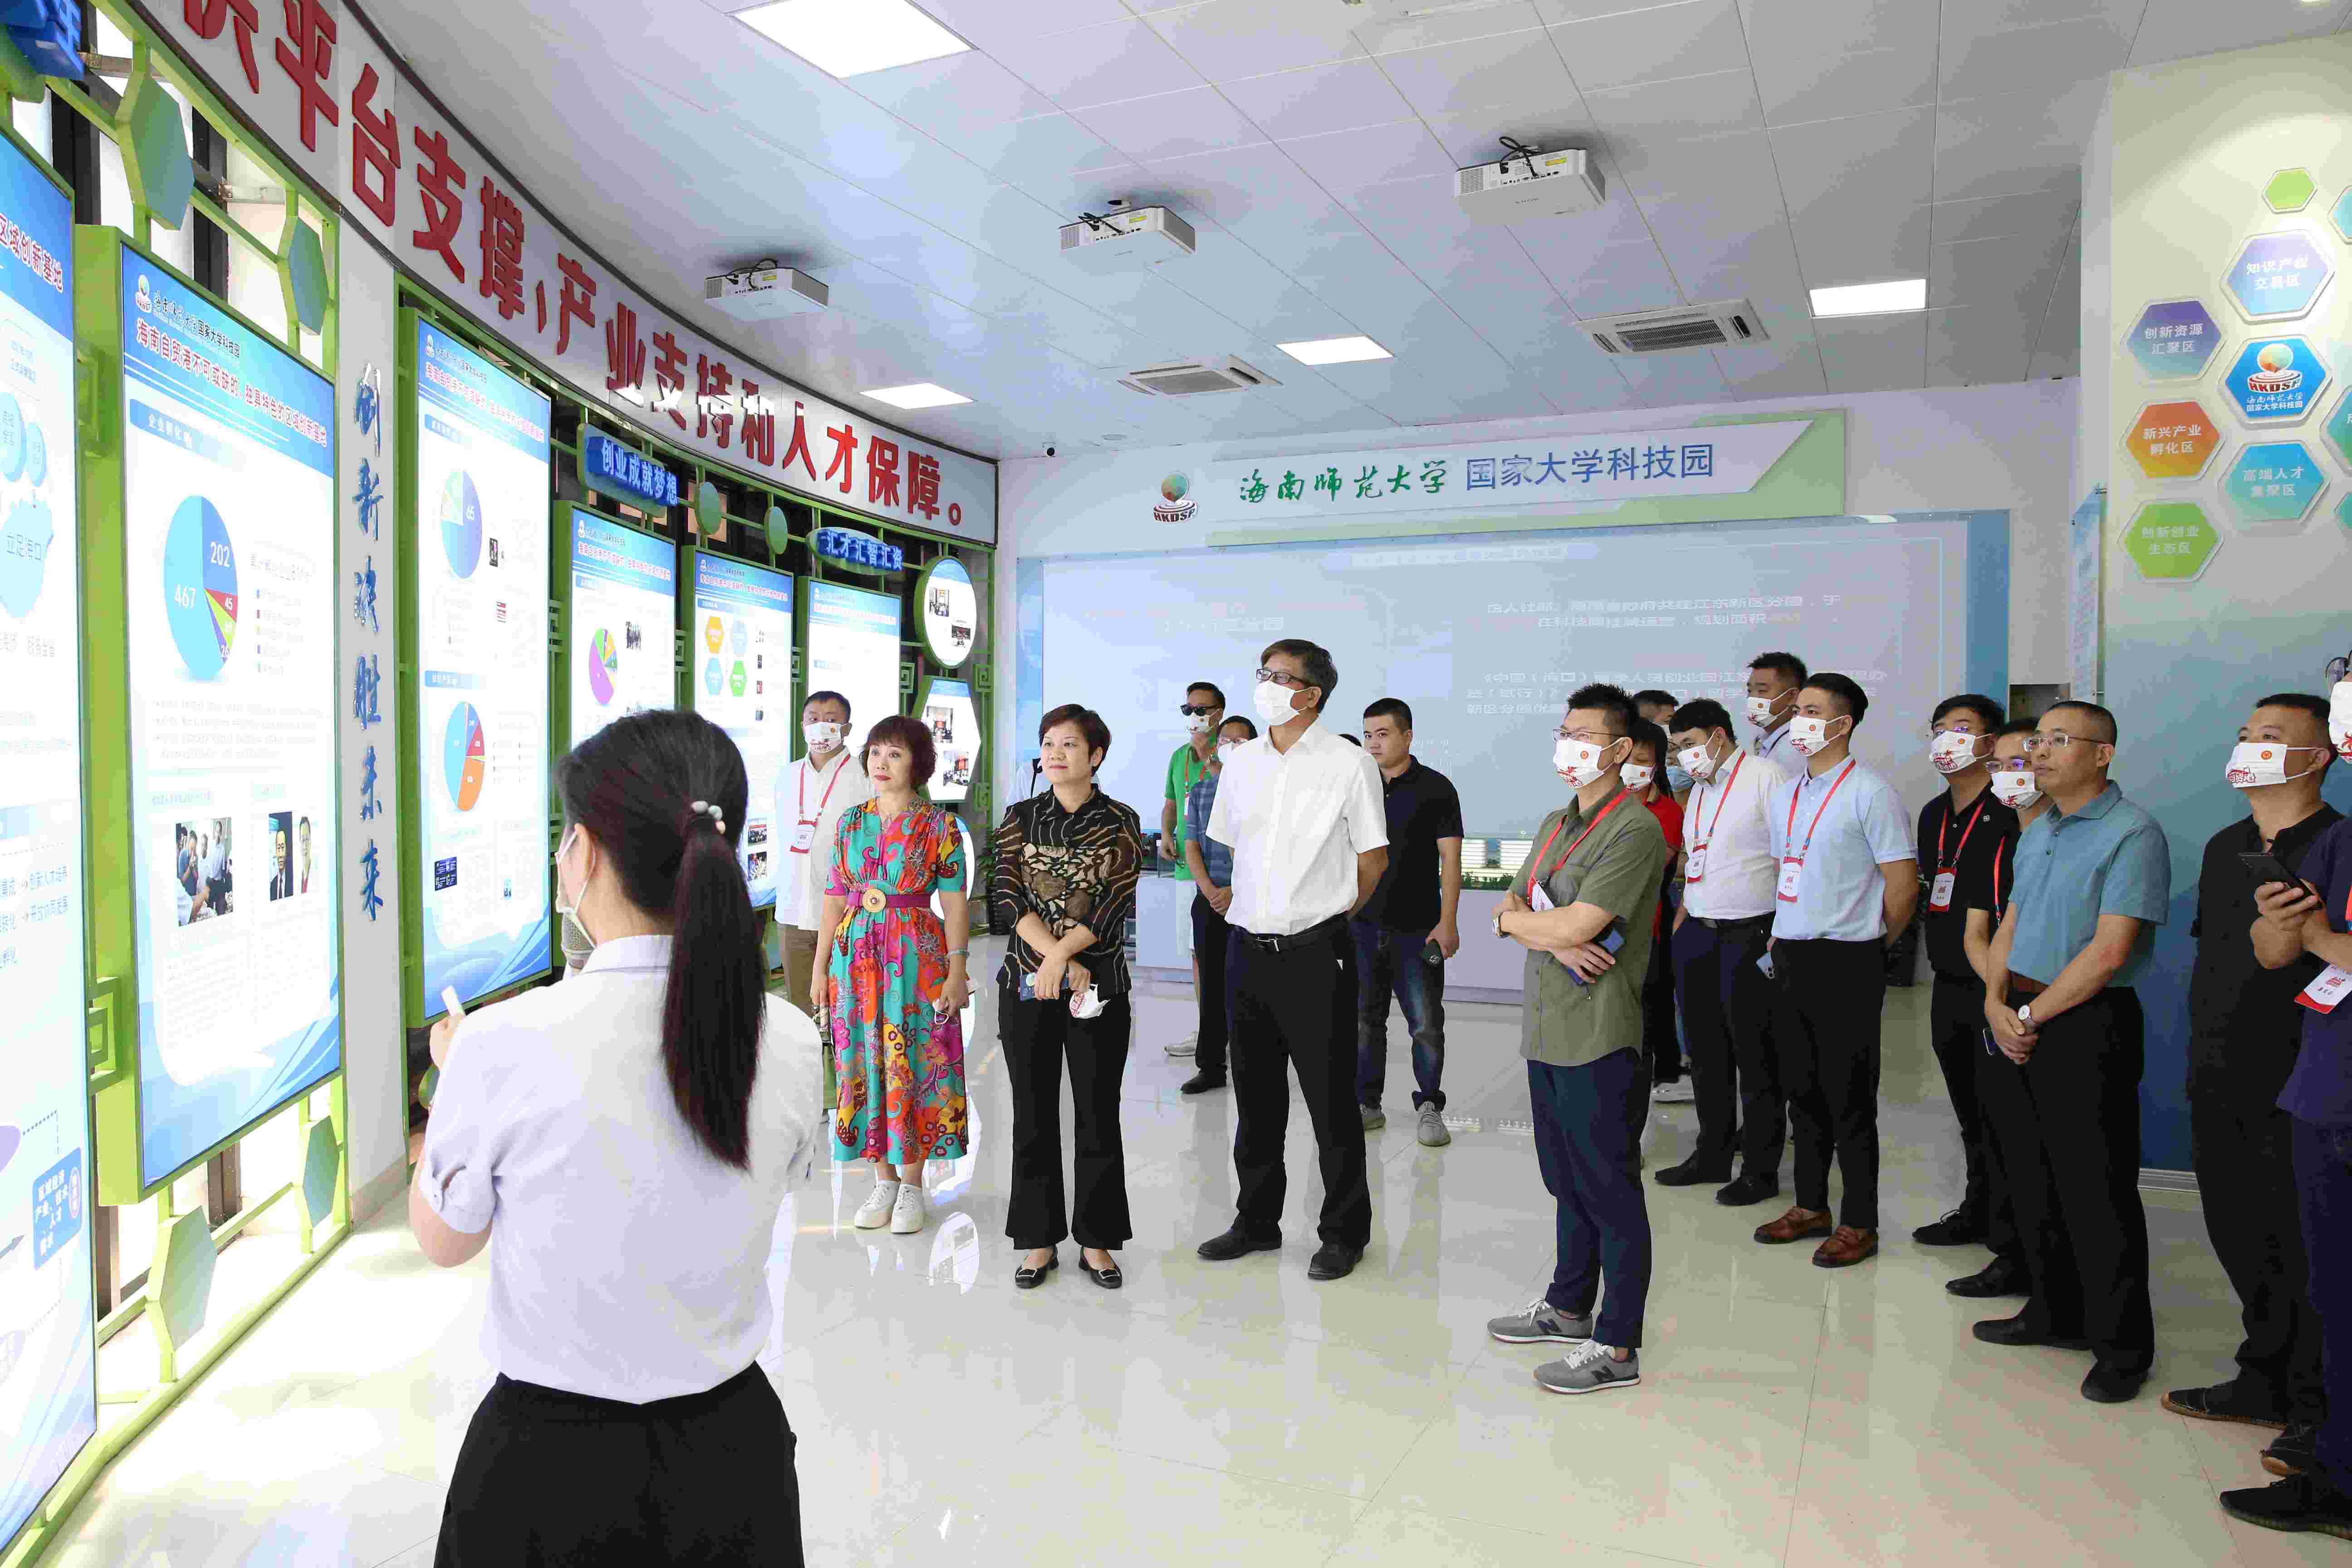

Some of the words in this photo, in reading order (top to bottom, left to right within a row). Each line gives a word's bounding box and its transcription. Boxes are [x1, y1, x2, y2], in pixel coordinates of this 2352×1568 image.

[2145, 323, 2204, 339] 创新资源
[2152, 341, 2196, 355] 汇聚区
[2247, 401, 2303, 412] 国家大学科技园
[2143, 424, 2203, 439] 新兴产业
[602, 439, 678, 505] 创业成就梦想
[1239, 461, 1446, 504] 海南师范大学
[1466, 444, 1713, 490] 国家大学科技园
[2243, 466, 2304, 482] 高端人才
[1153, 507, 1195, 523] HKDSP
[210, 542, 230, 568] 202
[827, 531, 903, 570] 汇才汇智汇资
[174, 584, 196, 609] 467
[225, 597, 233, 611] 45
